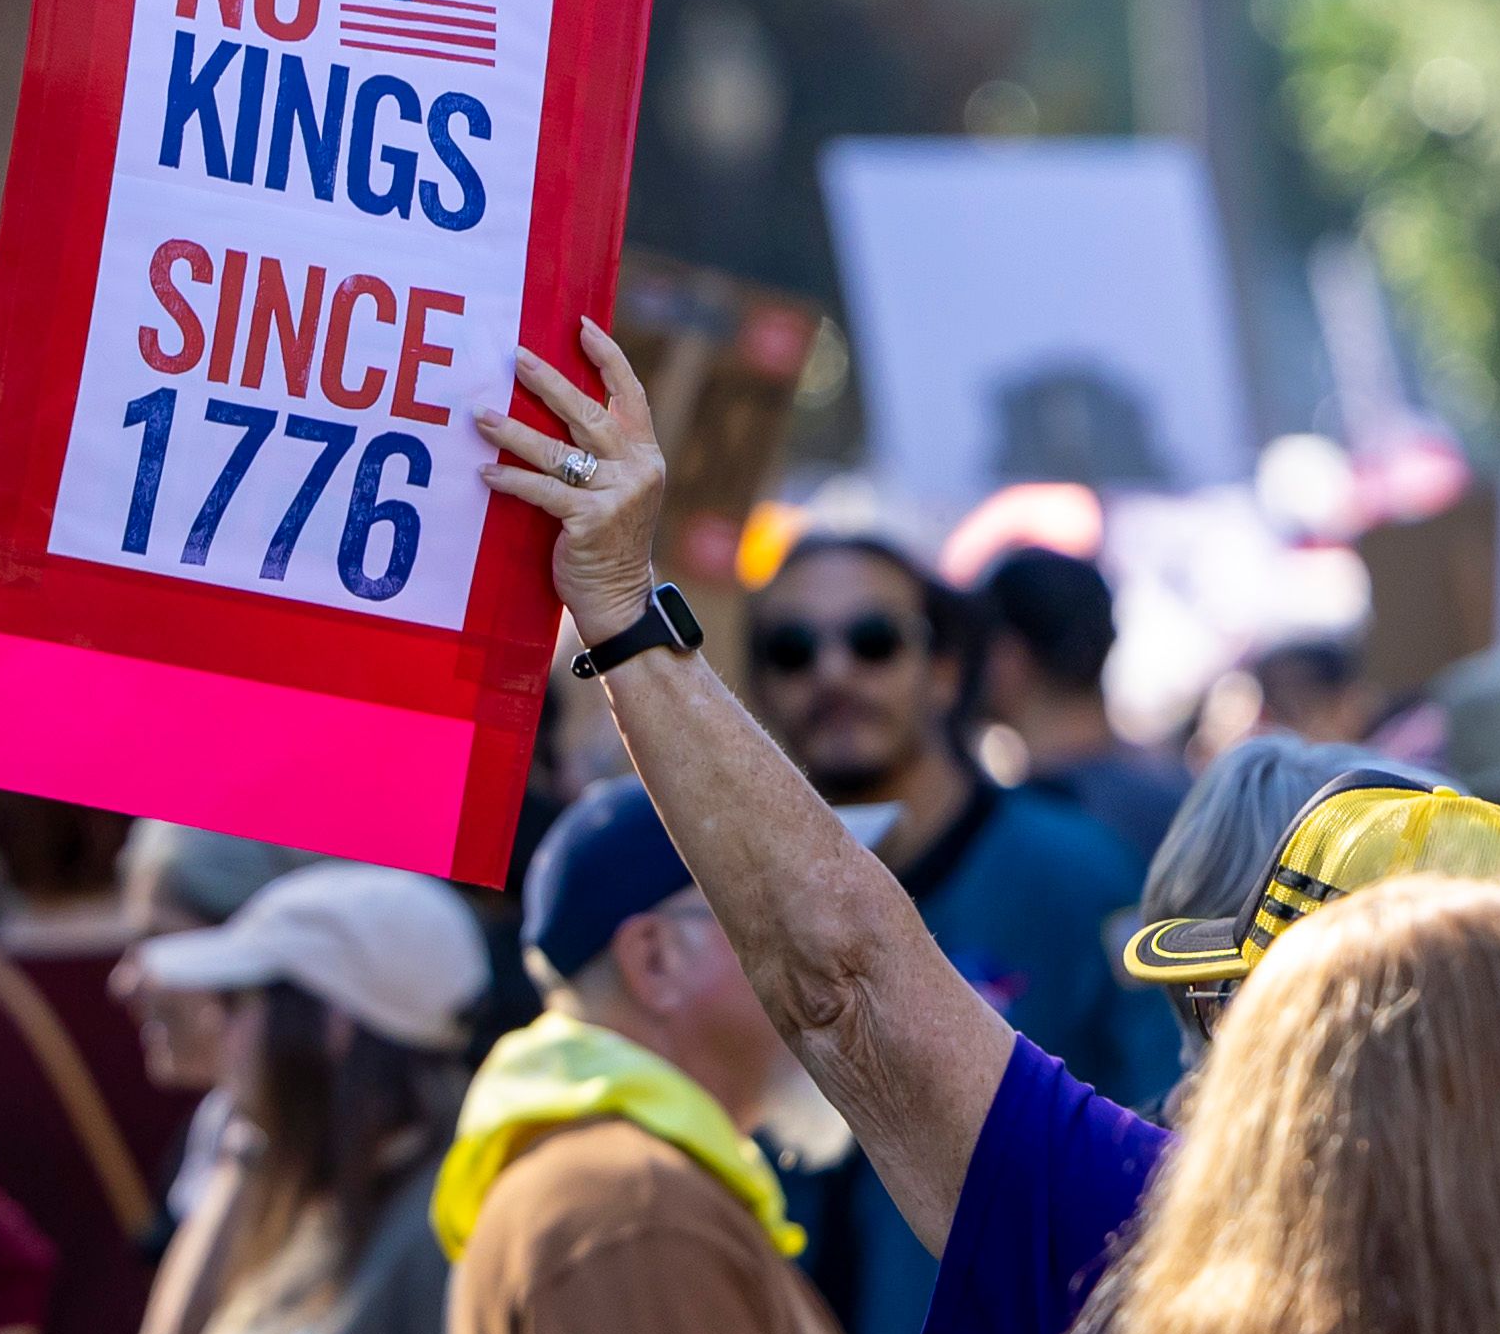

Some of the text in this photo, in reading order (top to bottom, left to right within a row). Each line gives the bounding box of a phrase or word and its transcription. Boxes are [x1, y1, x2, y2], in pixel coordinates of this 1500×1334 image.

[157, 28, 493, 233] KINGS
[137, 237, 466, 427] SINCE
[120, 385, 434, 603] 1776
